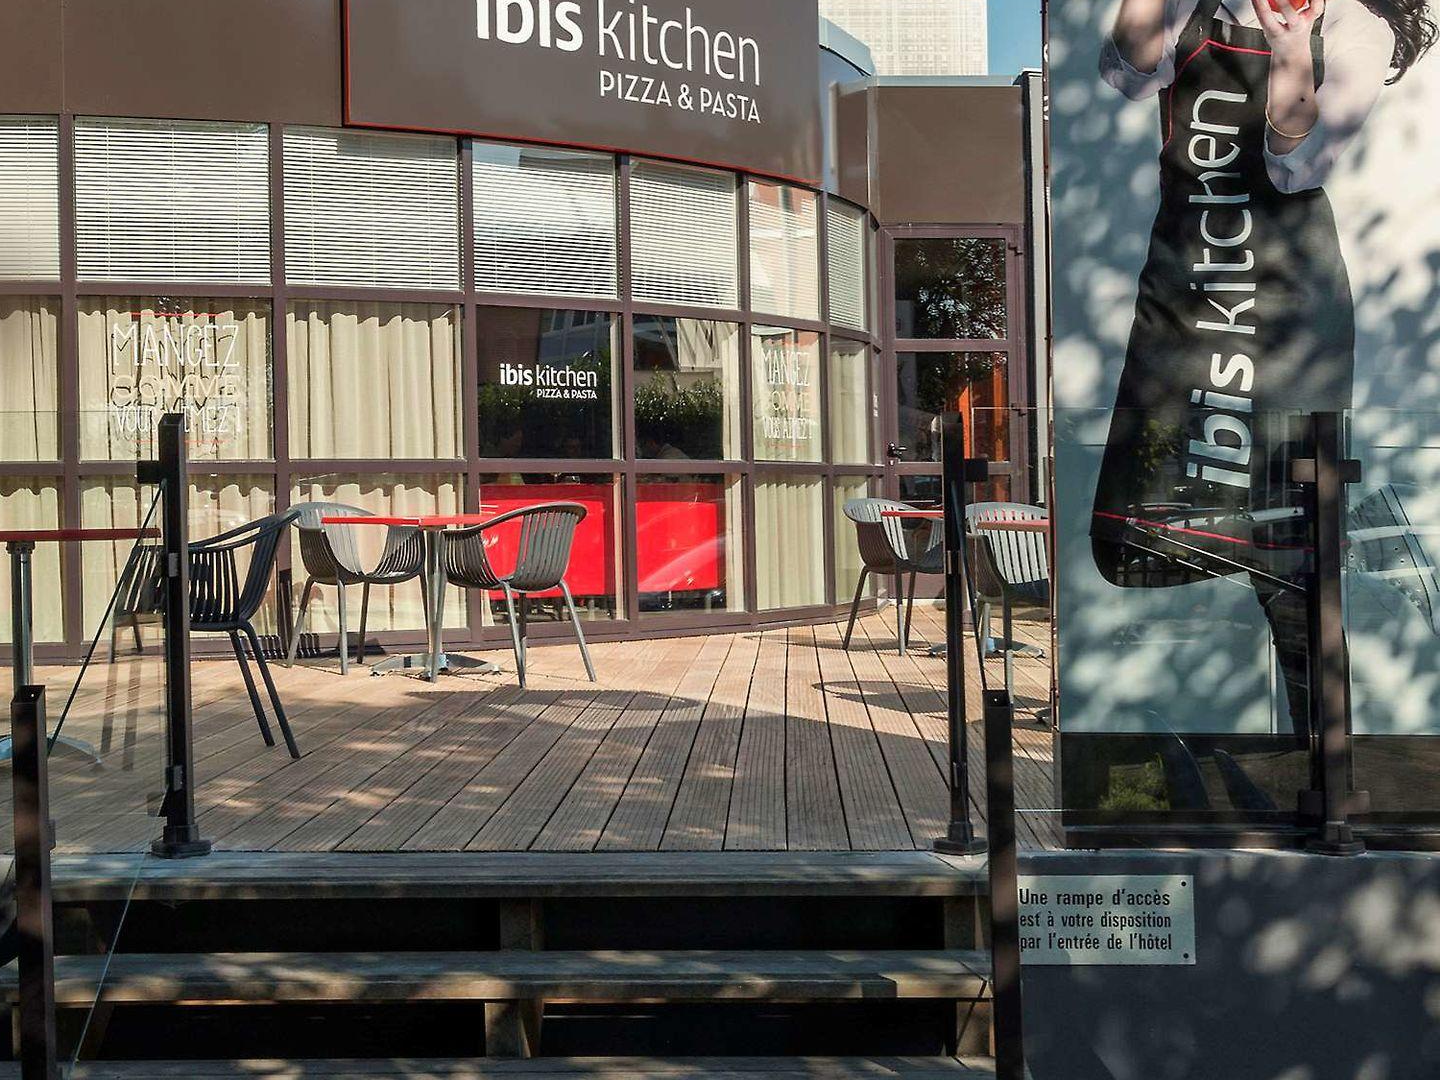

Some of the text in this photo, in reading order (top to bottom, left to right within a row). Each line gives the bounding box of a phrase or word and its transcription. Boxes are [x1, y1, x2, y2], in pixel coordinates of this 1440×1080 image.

[599, 70, 762, 124] PIZZA & PASTA
[1186, 88, 1257, 490] ibis kitchen
[113, 322, 240, 367] MANGEZ
[500, 363, 598, 388] ibis kitchen
[537, 388, 598, 399] PIZZA & PASTA
[172, 405, 229, 434] IMEZ
[1019, 888, 1171, 909] Une rampe d'accès
[1019, 910, 1172, 931] est à votre disposition
[1020, 933, 1173, 952] par l'entrée de l'hôtel
